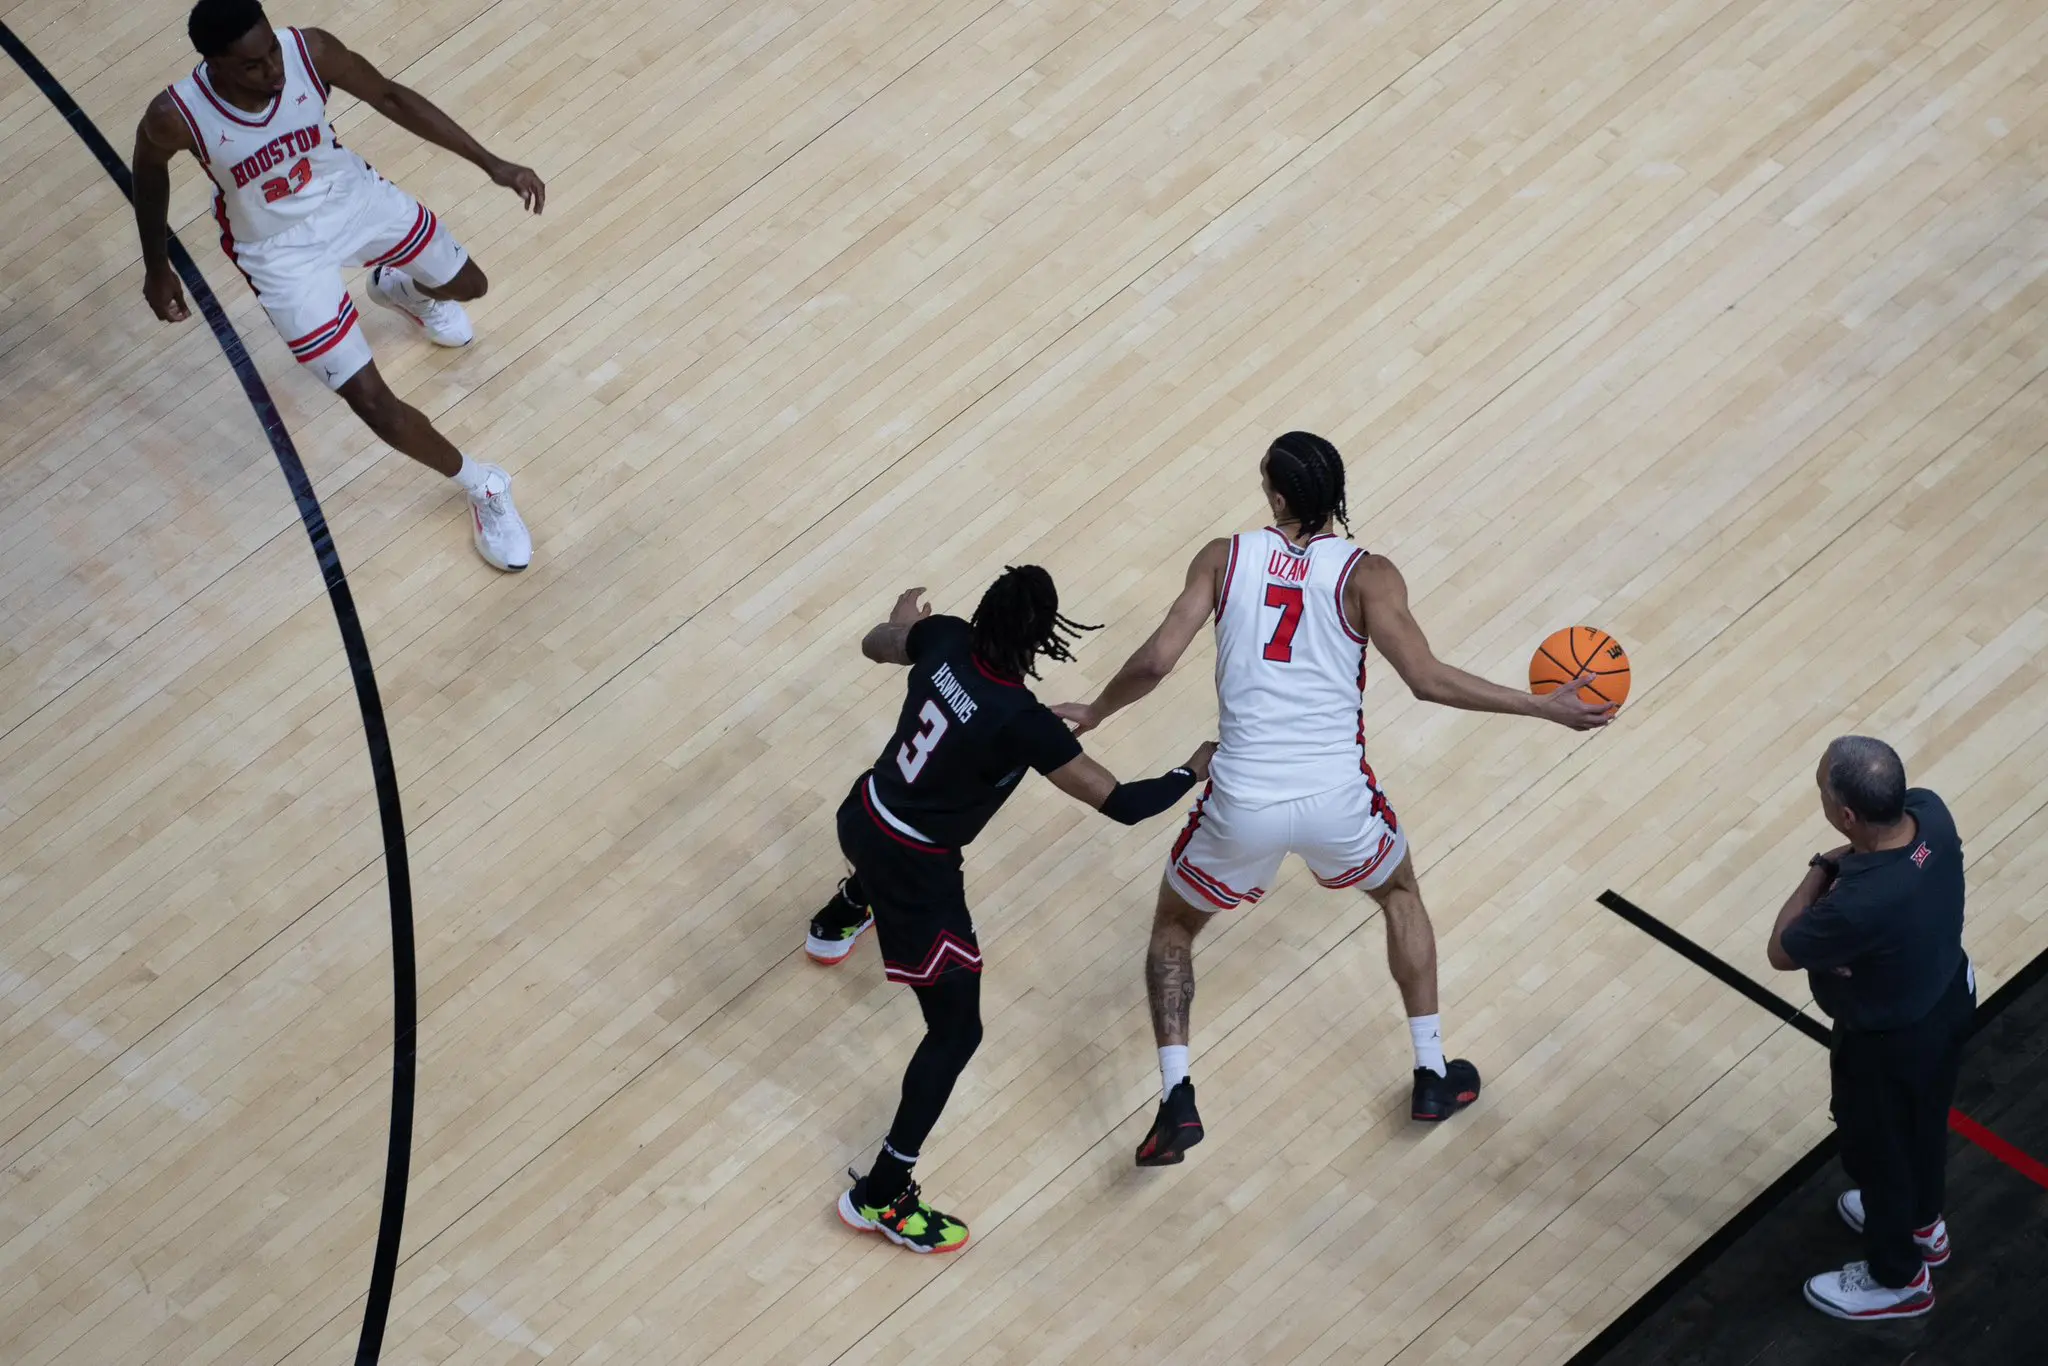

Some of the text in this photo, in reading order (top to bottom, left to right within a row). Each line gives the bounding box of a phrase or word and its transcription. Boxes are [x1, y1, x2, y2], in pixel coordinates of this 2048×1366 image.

[229, 124, 322, 189] HOUSTON
[261, 157, 313, 204] 23
[1268, 549, 1310, 581] UZAN
[1262, 583, 1304, 664] 7
[930, 661, 978, 724] HAWKINS
[896, 699, 949, 784] 3
